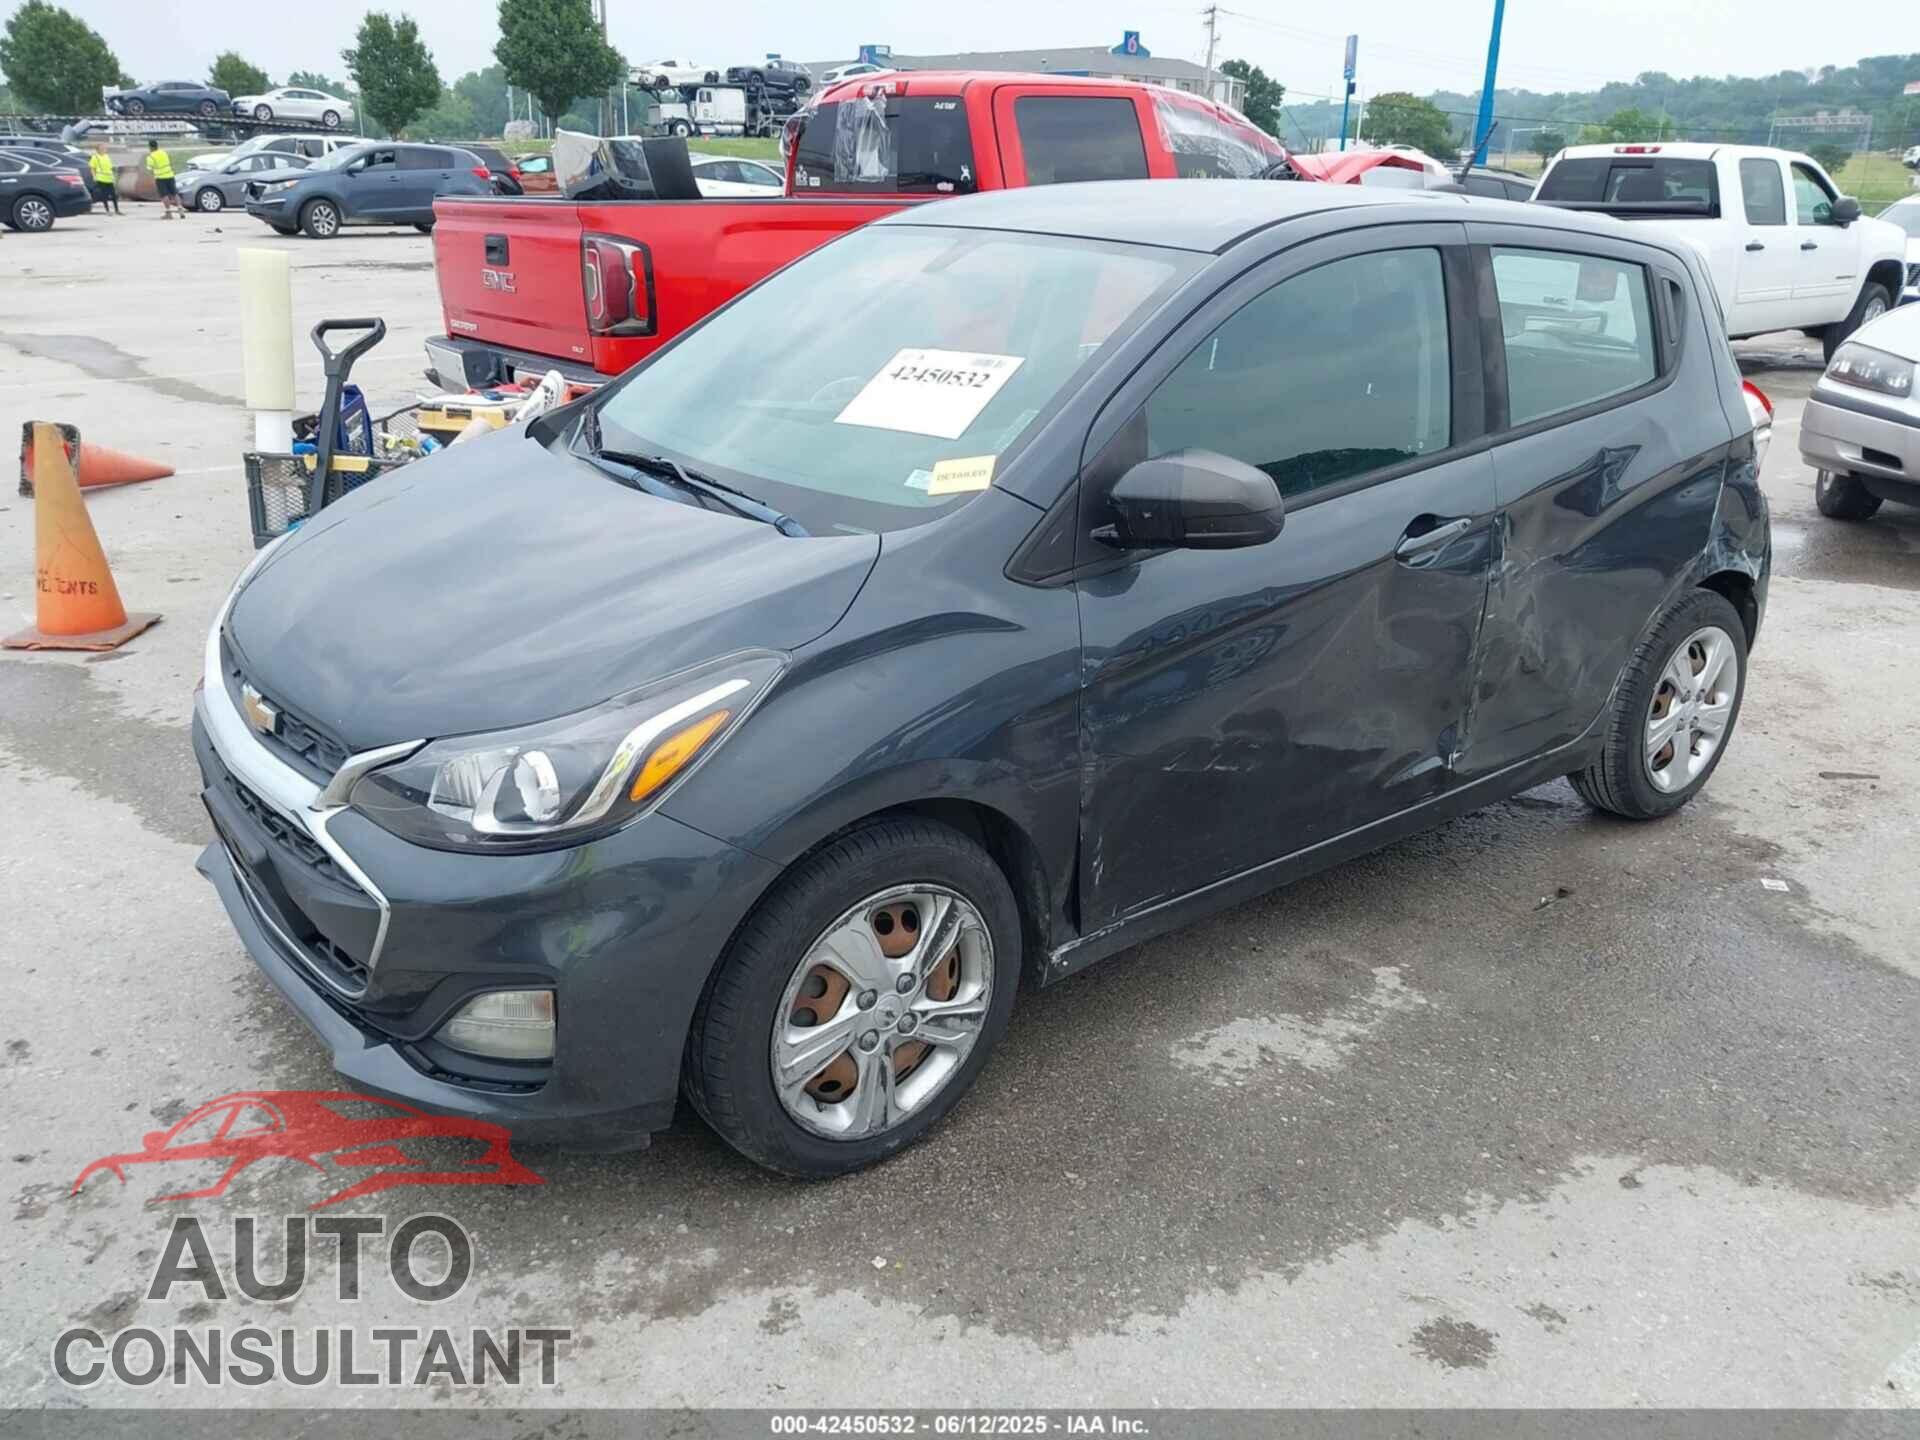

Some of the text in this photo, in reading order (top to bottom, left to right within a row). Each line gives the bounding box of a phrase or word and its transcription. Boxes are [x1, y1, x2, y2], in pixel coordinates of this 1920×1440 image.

[1127, 34, 1137, 54] 6
[481, 269, 518, 294] GMC
[889, 365, 991, 389] 42450532
